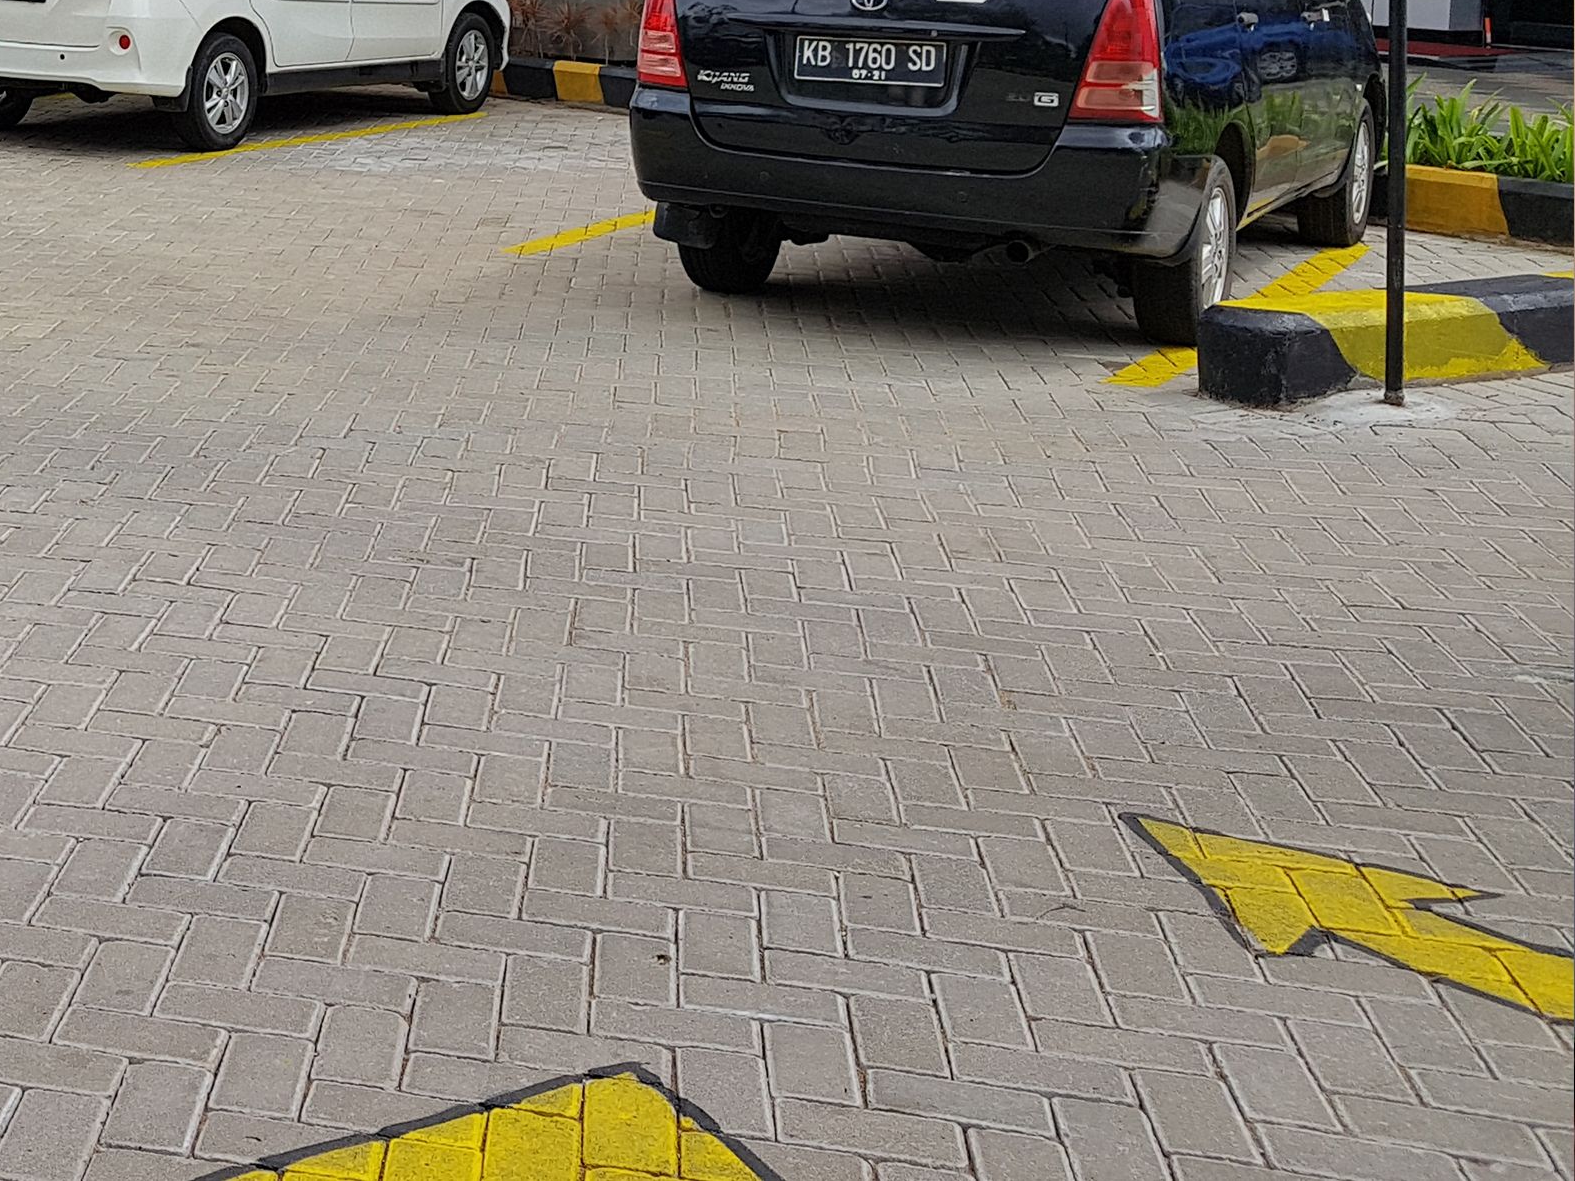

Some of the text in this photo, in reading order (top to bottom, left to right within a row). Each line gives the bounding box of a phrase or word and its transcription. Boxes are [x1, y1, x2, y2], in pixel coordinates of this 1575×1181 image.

[802, 39, 936, 72] KB 1760 SD
[697, 70, 751, 83] KIJANG
[720, 82, 754, 91] INNOVA
